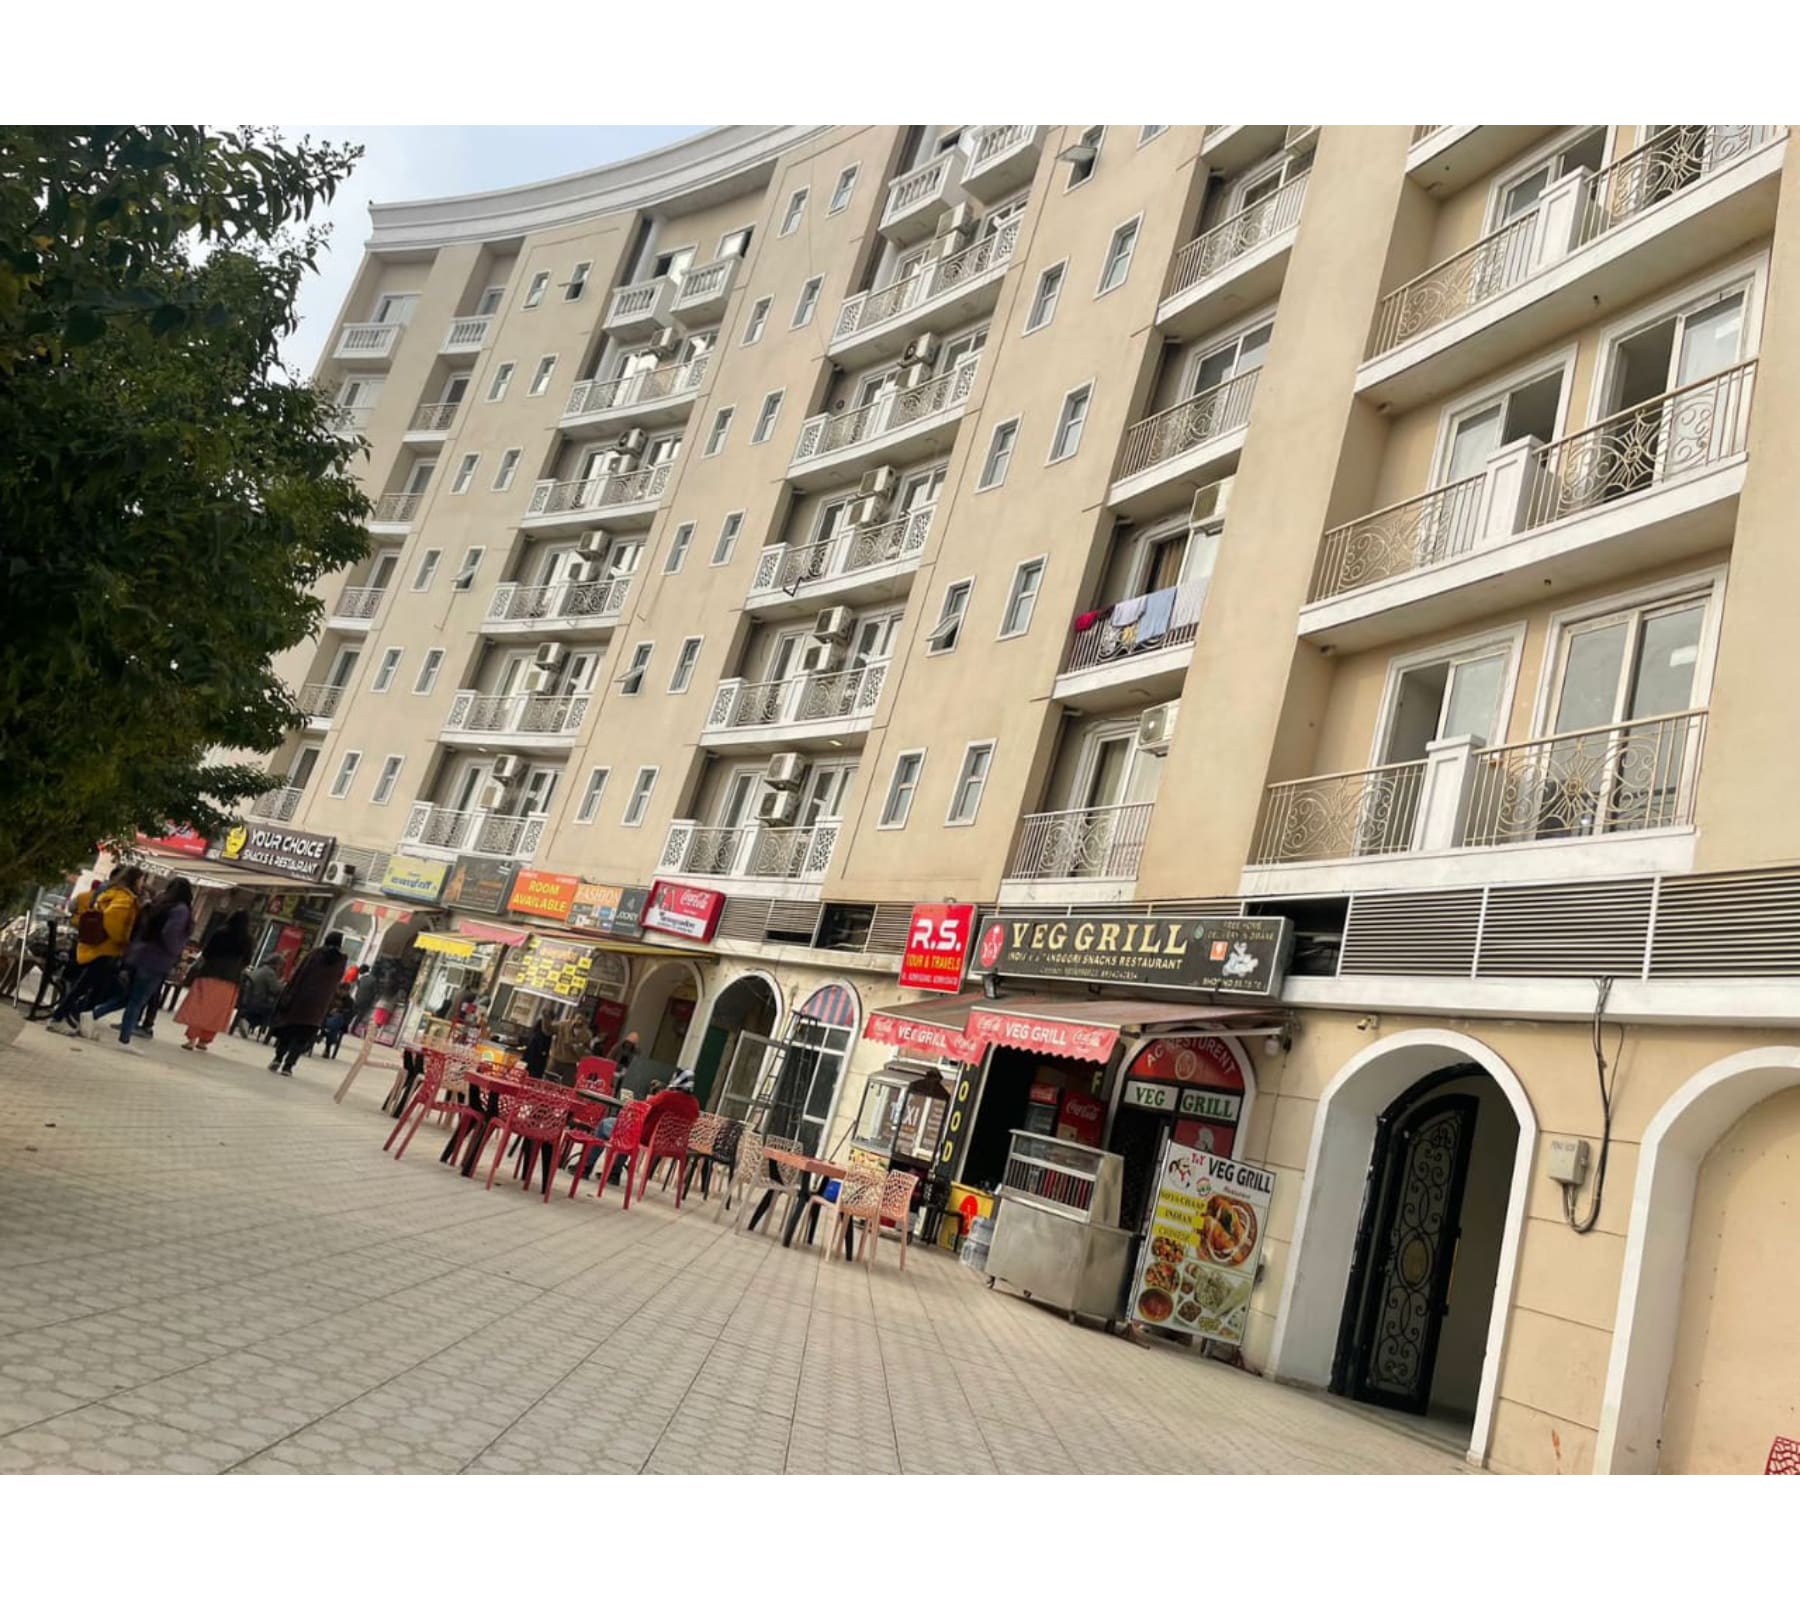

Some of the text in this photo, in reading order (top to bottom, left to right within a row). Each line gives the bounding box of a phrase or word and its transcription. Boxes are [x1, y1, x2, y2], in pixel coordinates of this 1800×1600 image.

[251, 828, 326, 859] YOUR CHOICE
[528, 880, 560, 895] ROOM
[512, 893, 567, 912] AVAILABLE
[910, 918, 962, 951] R.S.
[1012, 922, 1068, 950] VEG
[1074, 922, 1188, 955] GRILL
[906, 954, 923, 966] TOUR
[931, 956, 961, 970] TRAVELS
[1082, 955, 1117, 967] SNACKS
[1119, 956, 1184, 970] RESTAURANT
[920, 1031, 946, 1048] GRILL
[1005, 1022, 1068, 1045] VEG GRILL
[1147, 1044, 1165, 1068] AC
[1136, 1086, 1233, 1118] VEG GRILL
[1208, 1157, 1272, 1194] VEG GRILL
[1165, 1208, 1193, 1224] INDIAN
